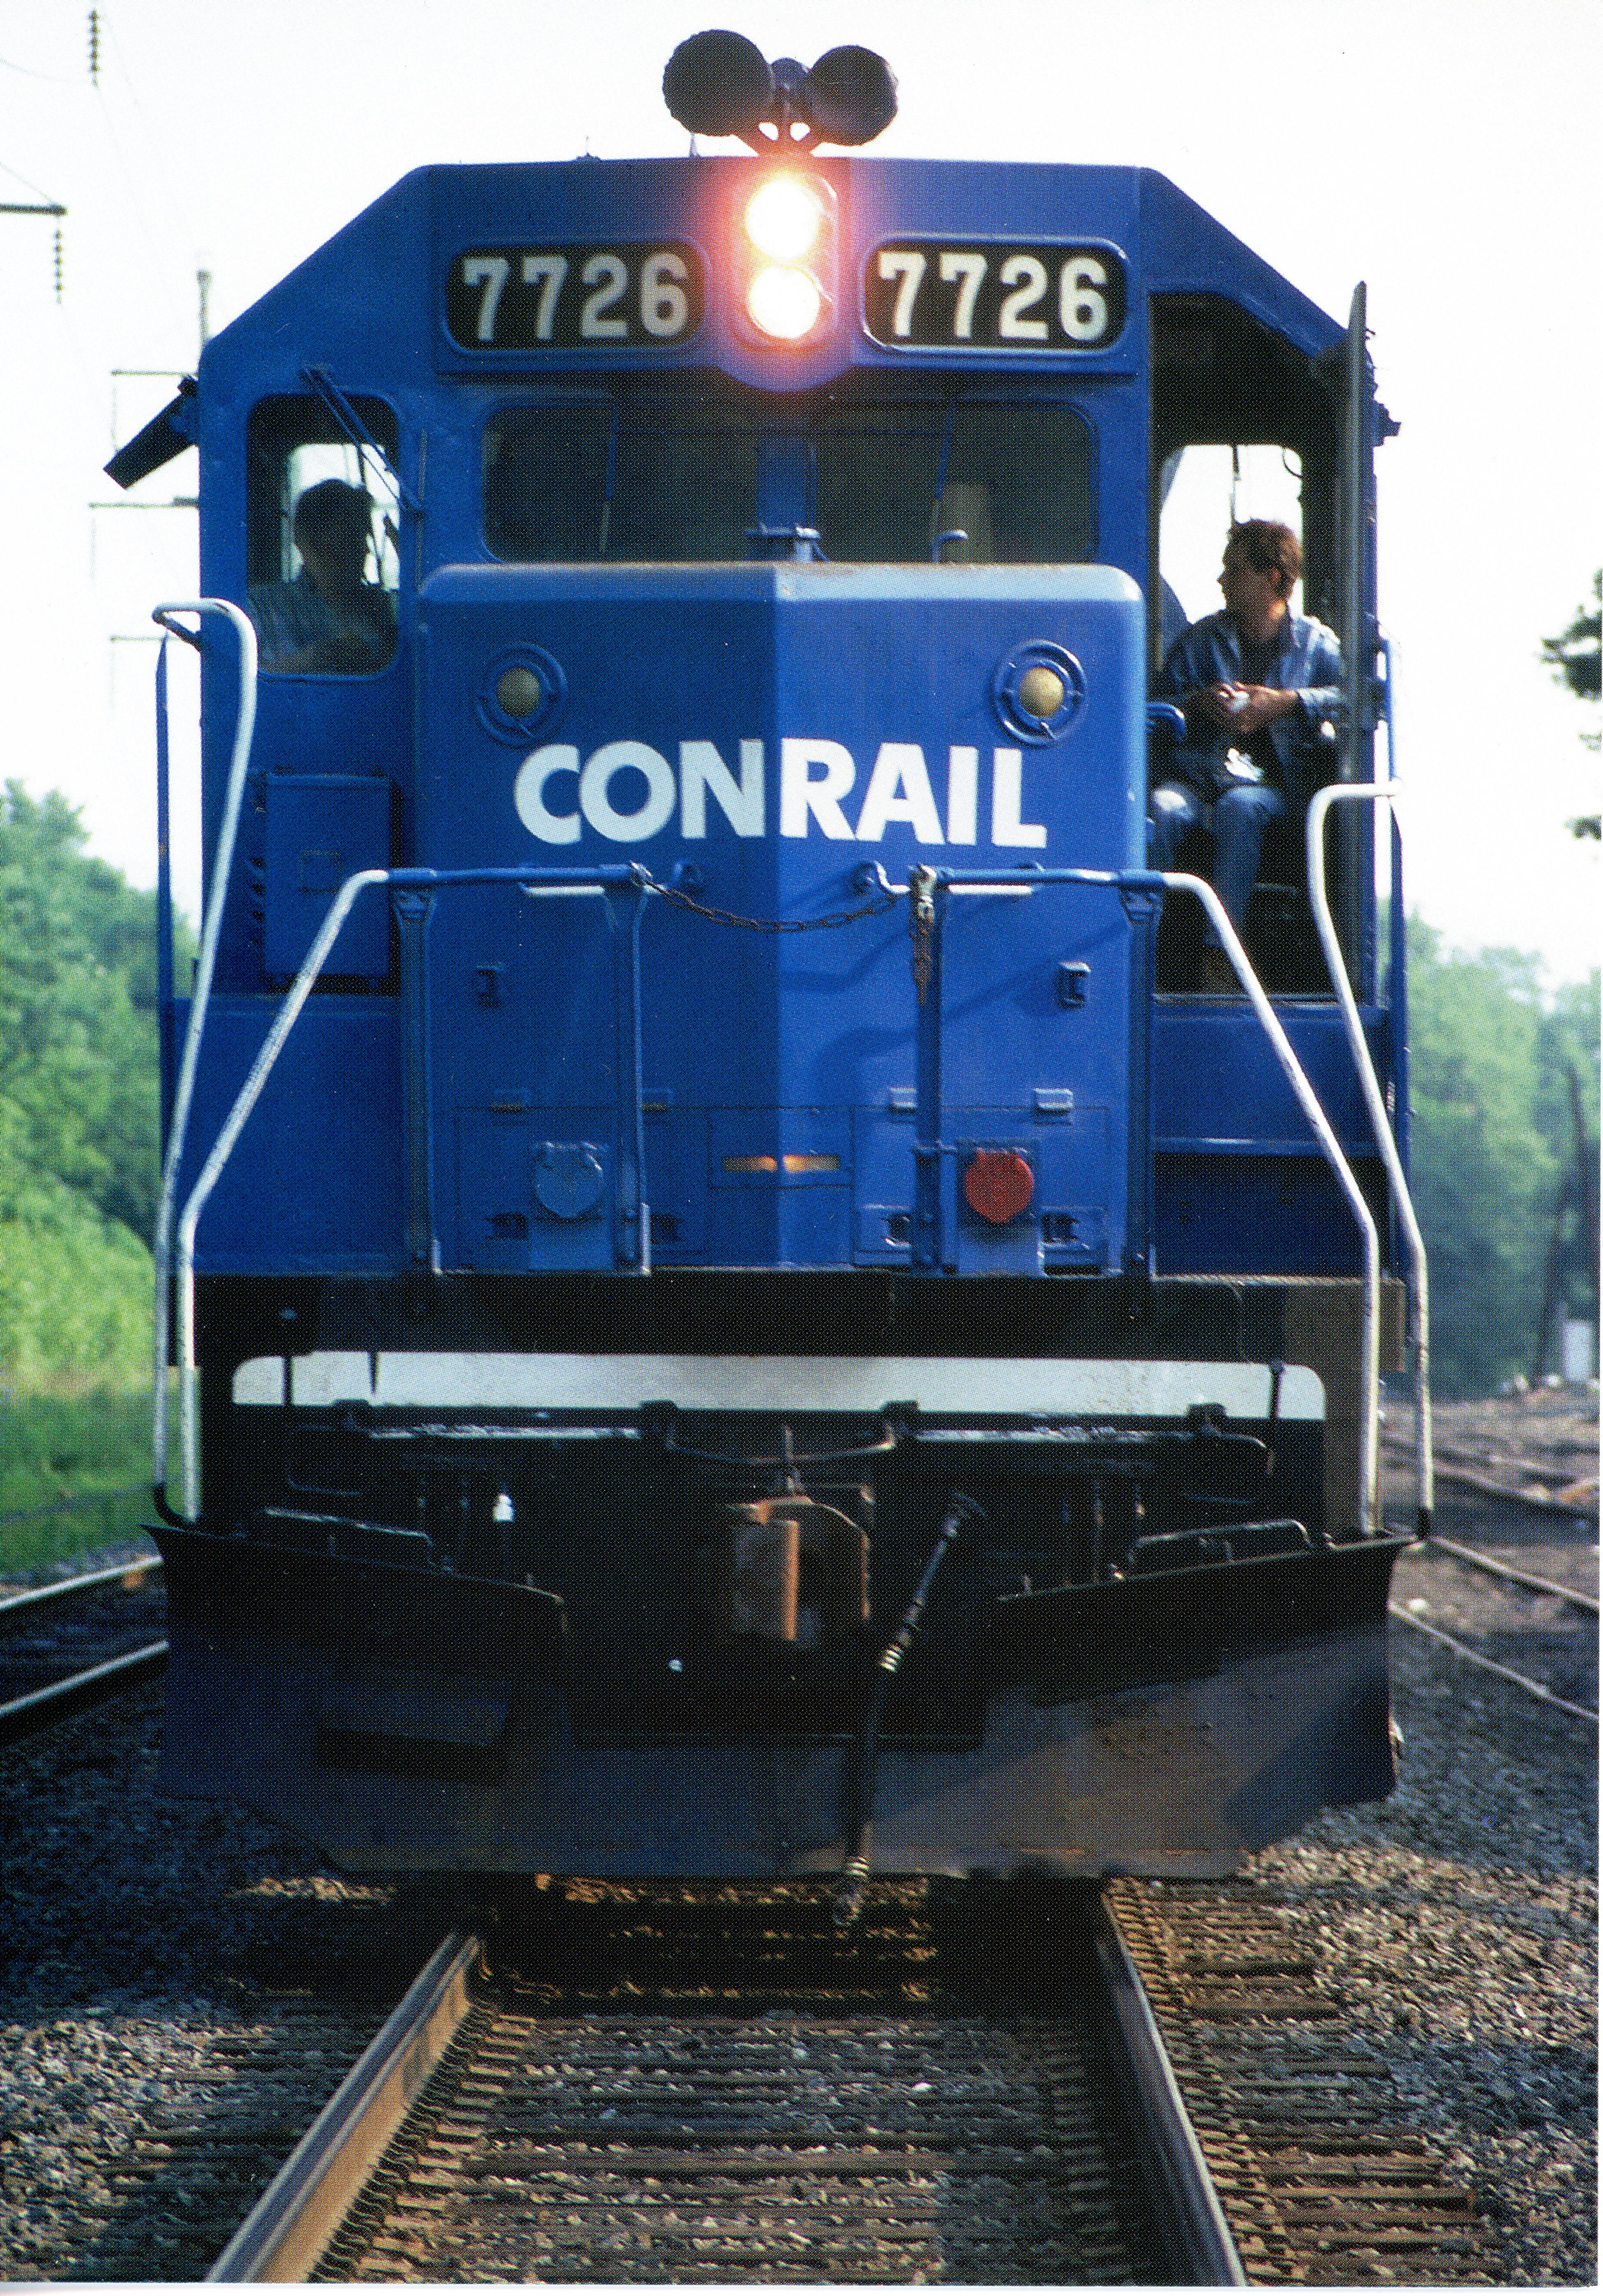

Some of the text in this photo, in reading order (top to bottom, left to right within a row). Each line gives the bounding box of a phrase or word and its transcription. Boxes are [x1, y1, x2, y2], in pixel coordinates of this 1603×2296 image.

[463, 254, 688, 341] 7726
[879, 252, 1107, 341] 7726
[514, 738, 1047, 847] CONRAIL
